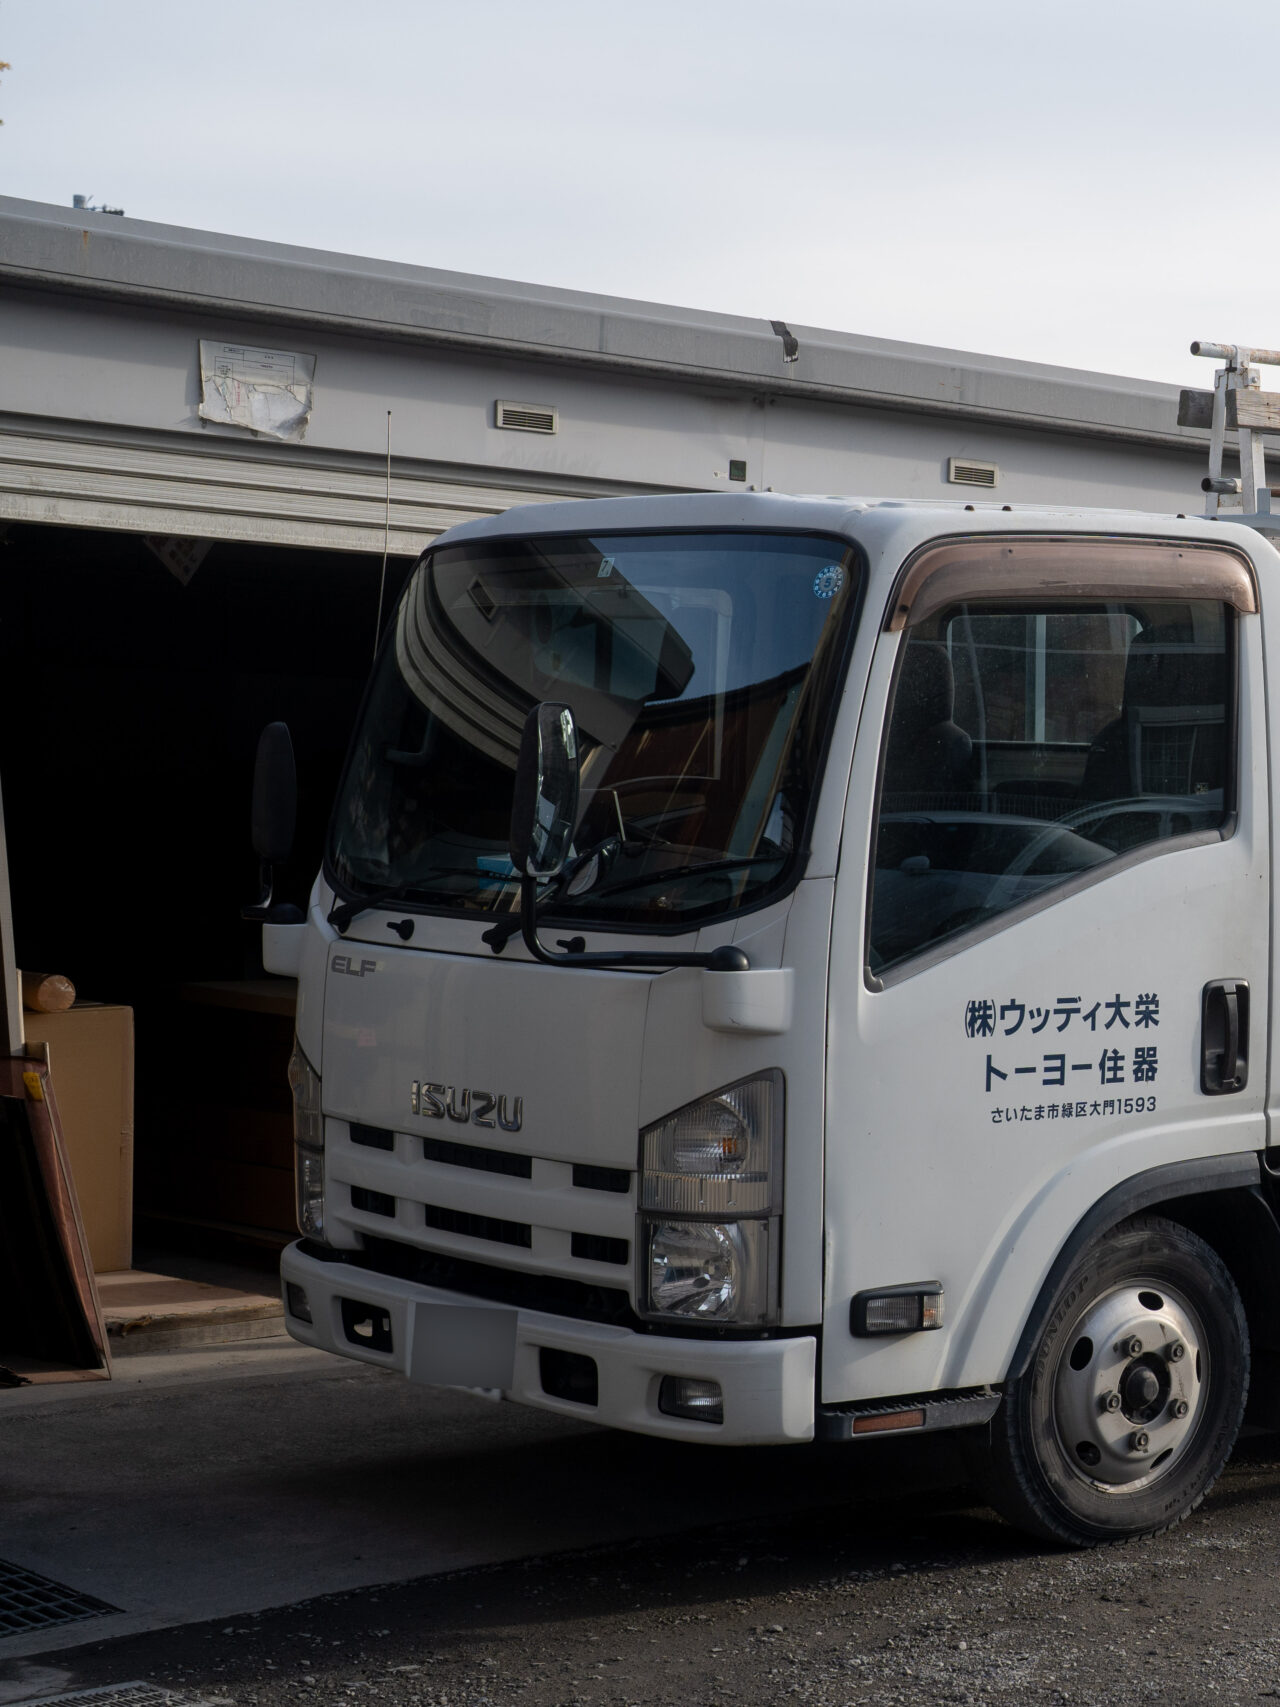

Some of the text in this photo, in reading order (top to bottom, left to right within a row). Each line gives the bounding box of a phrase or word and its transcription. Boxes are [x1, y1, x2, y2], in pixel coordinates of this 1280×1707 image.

[823, 577, 832, 588] 5
[331, 955, 376, 977] ELF
[965, 993, 1160, 1038] (株)ウッディ大栄
[985, 1046, 1158, 1093] トーヨー住器
[411, 1080, 523, 1133] ISUZU
[991, 1096, 1157, 1124] さいたま市緑区大門1593
